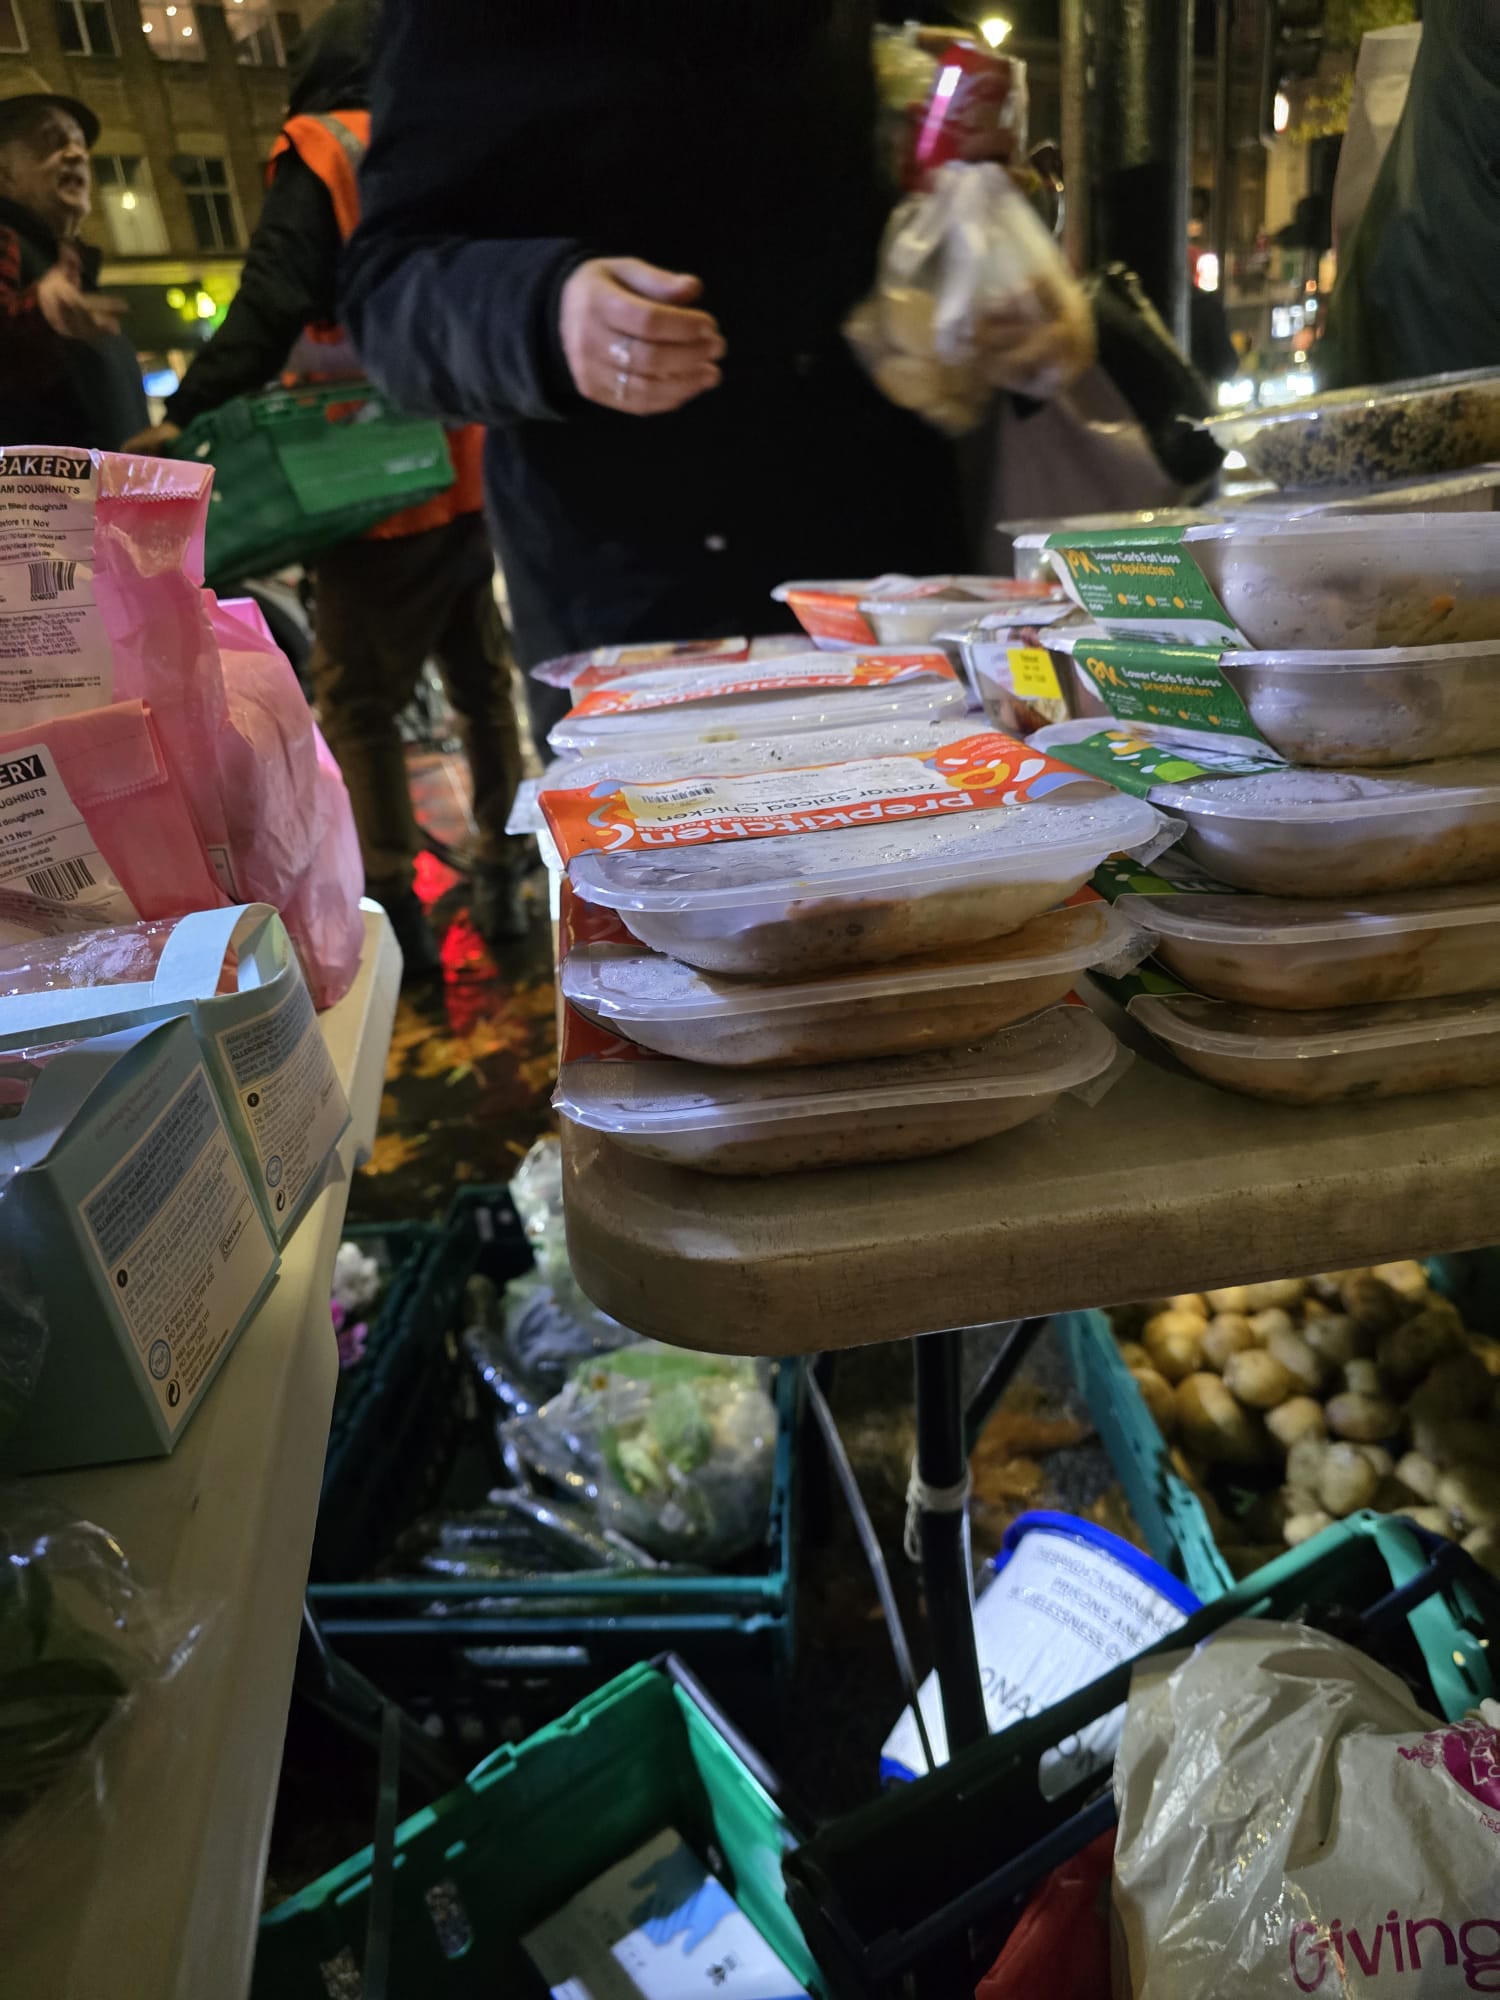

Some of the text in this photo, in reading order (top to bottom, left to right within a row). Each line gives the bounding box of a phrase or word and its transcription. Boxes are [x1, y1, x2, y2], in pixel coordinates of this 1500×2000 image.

[17, 485, 80, 494] DOUGHNUTS
[29, 504, 68, 512] doughnuts
[1117, 551, 1142, 562] Carb
[1141, 552, 1158, 563] Fat
[1157, 553, 1180, 564] Loss
[1101, 563, 1176, 577] by prepkitchen
[1121, 667, 1222, 688] Lower Carb Fat Loss
[1142, 681, 1214, 698] prepkitchen
[860, 783, 942, 798] Zaatar
[769, 794, 851, 813] Spiced
[2, 808, 45, 826] doughnuts
[640, 792, 974, 844] prepkitchen
[657, 805, 759, 823] Chicken
[636, 814, 793, 833] Balanced Fat Loss
[15, 830, 33, 840] Nov
[1289, 1909, 1500, 1993] Giving
